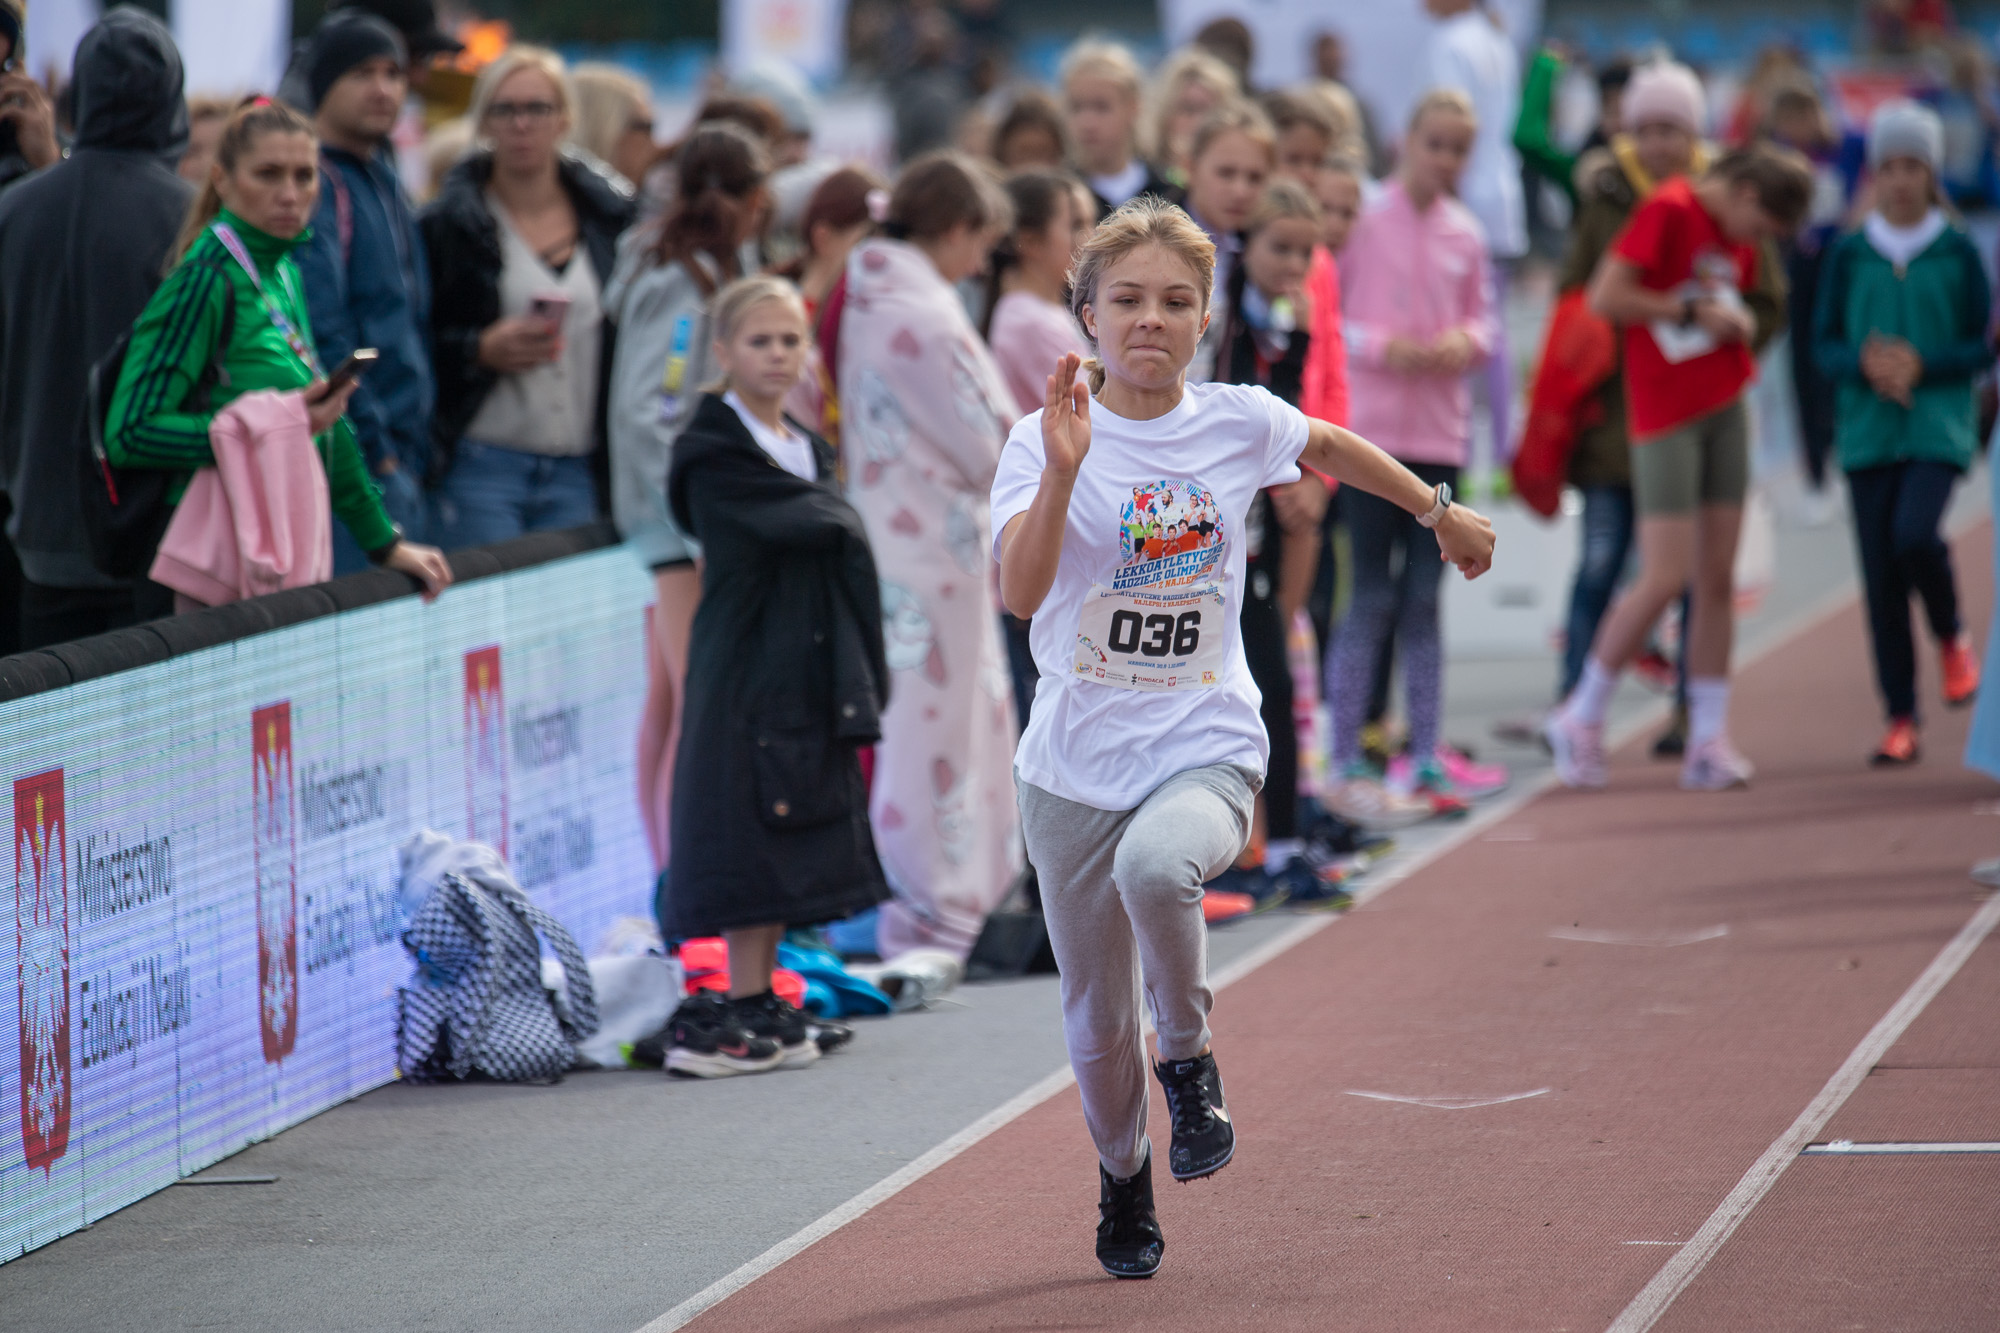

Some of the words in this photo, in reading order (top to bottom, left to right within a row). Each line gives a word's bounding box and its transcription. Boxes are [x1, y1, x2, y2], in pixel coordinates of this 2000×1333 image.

[1114, 541, 1226, 580] LEKKOATLETYCZNE
[1112, 571, 1162, 590] NADZIEJE
[1134, 599, 1162, 608] NAJLEPSI
[1108, 609, 1202, 657] 036
[1138, 676, 1165, 684] FUNDACJA
[76, 824, 171, 927] Ministerstwo
